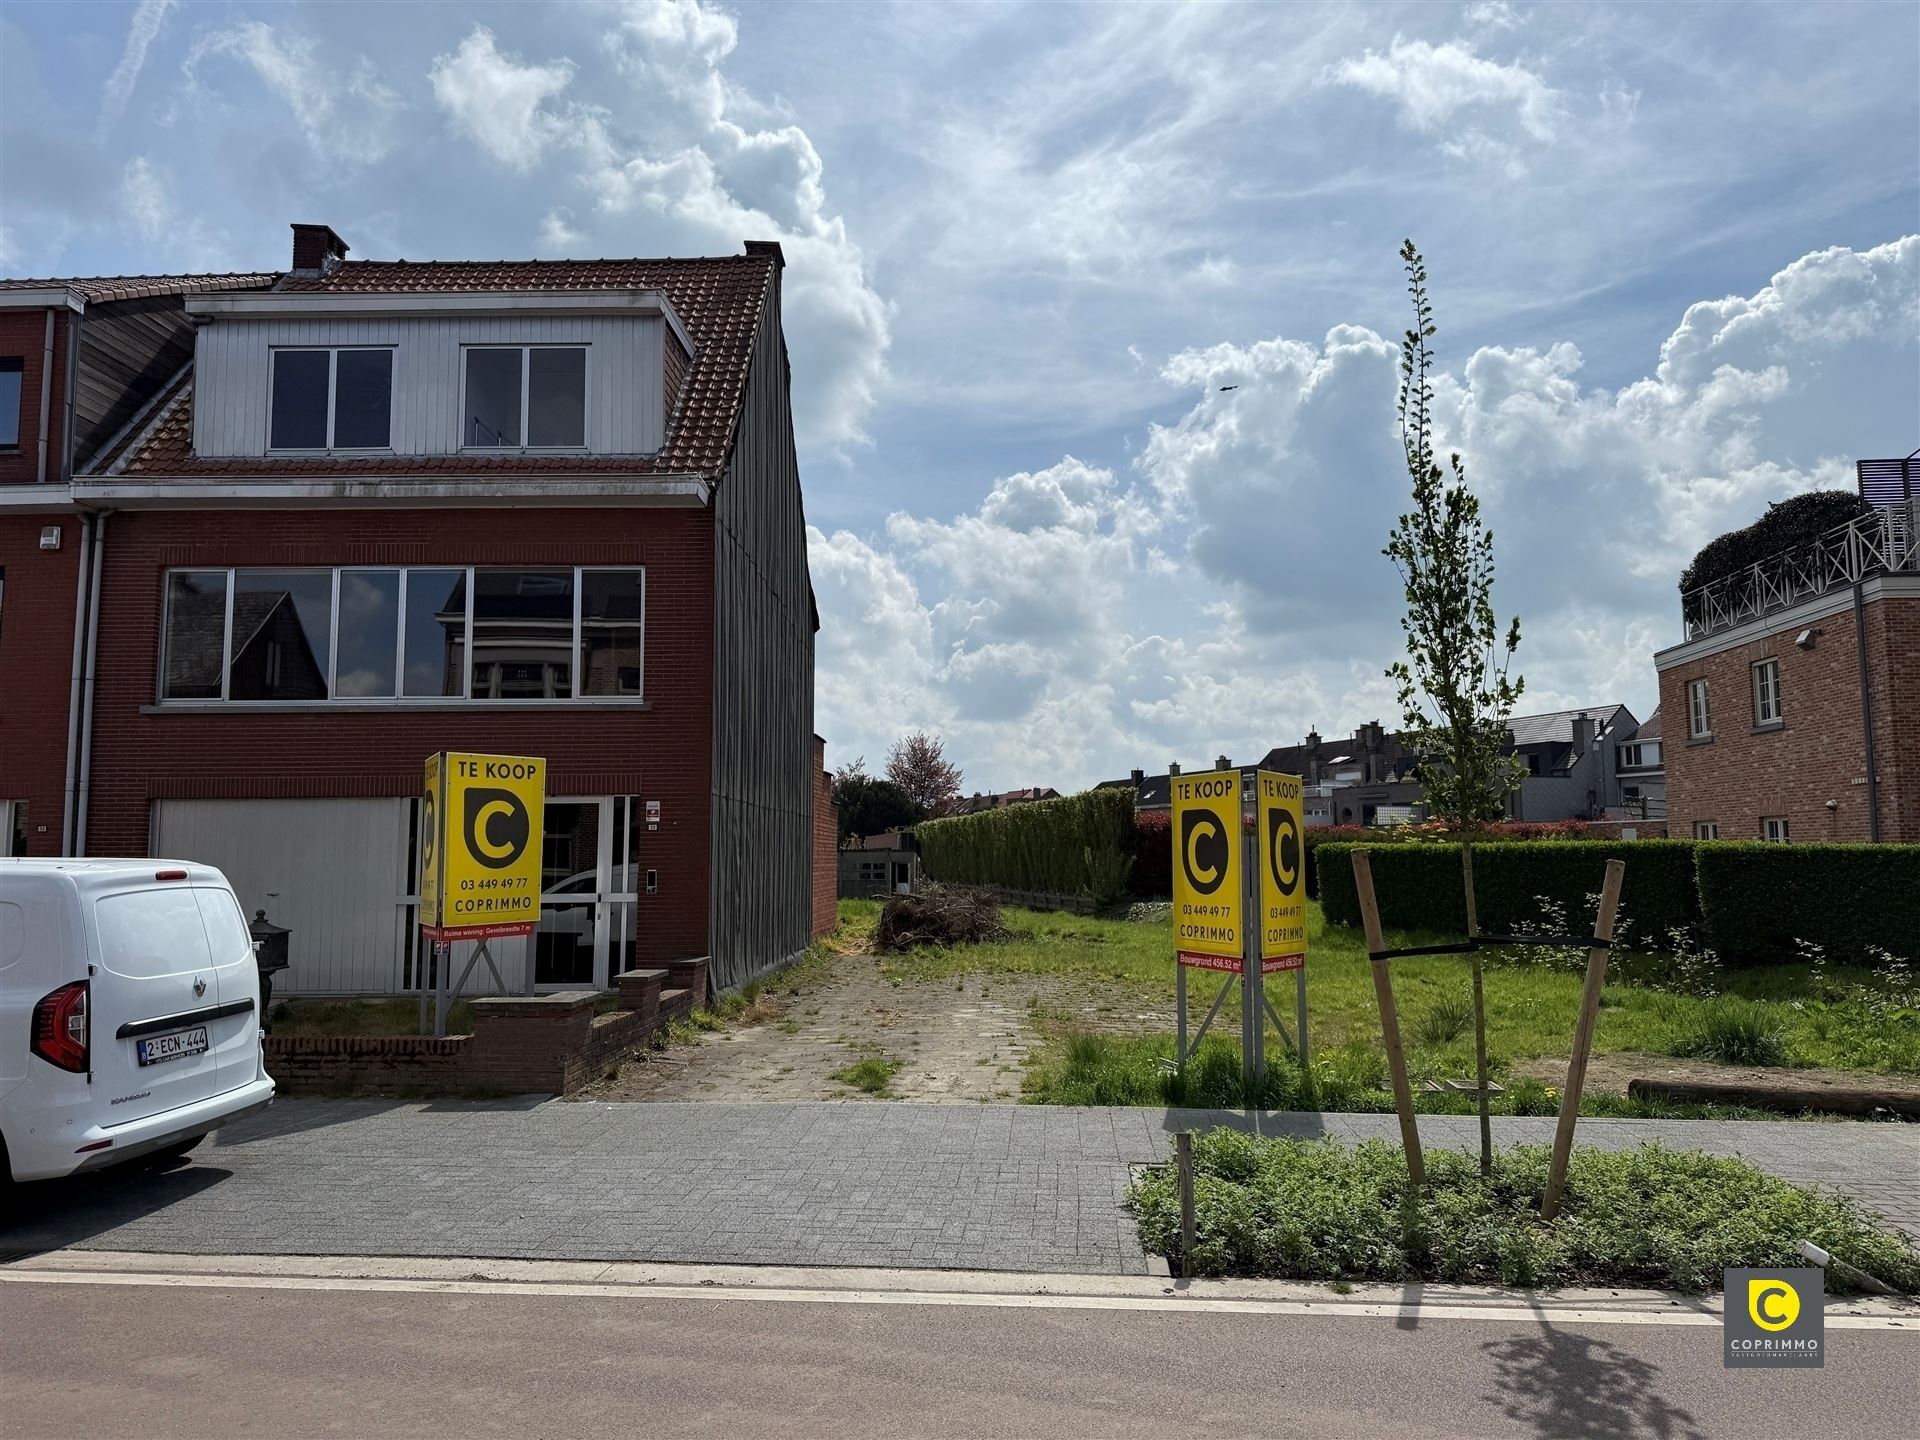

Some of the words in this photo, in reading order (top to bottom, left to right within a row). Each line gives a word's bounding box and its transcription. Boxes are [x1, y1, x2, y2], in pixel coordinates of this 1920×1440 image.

[458, 761, 478, 778] TE
[485, 762, 537, 780] KOOP
[1178, 784, 1191, 800] TE
[1195, 779, 1232, 799] KOOP
[1264, 780, 1274, 797] TE
[1277, 781, 1299, 799] KOOP
[460, 879, 475, 891] 03
[477, 878, 498, 890] 449
[500, 878, 514, 890] 49
[515, 877, 528, 888] 77
[455, 896, 532, 913] COPRIMMO
[1183, 904, 1193, 915] 03
[1193, 905, 1208, 917] 449
[1209, 906, 1220, 917] 49
[1220, 907, 1231, 918] 77
[1270, 908, 1279, 919] 03
[1279, 907, 1289, 918] 449
[1289, 906, 1297, 917] 49
[443, 929, 462, 937] Ruime
[463, 928, 485, 937] woning:
[1180, 924, 1234, 942] COPRIMMO
[1268, 926, 1304, 943] COPRIMMO
[1179, 953, 1212, 967] Bouwgrond
[1212, 958, 1232, 969] 456.52
[1263, 959, 1285, 971] Bouwgrond
